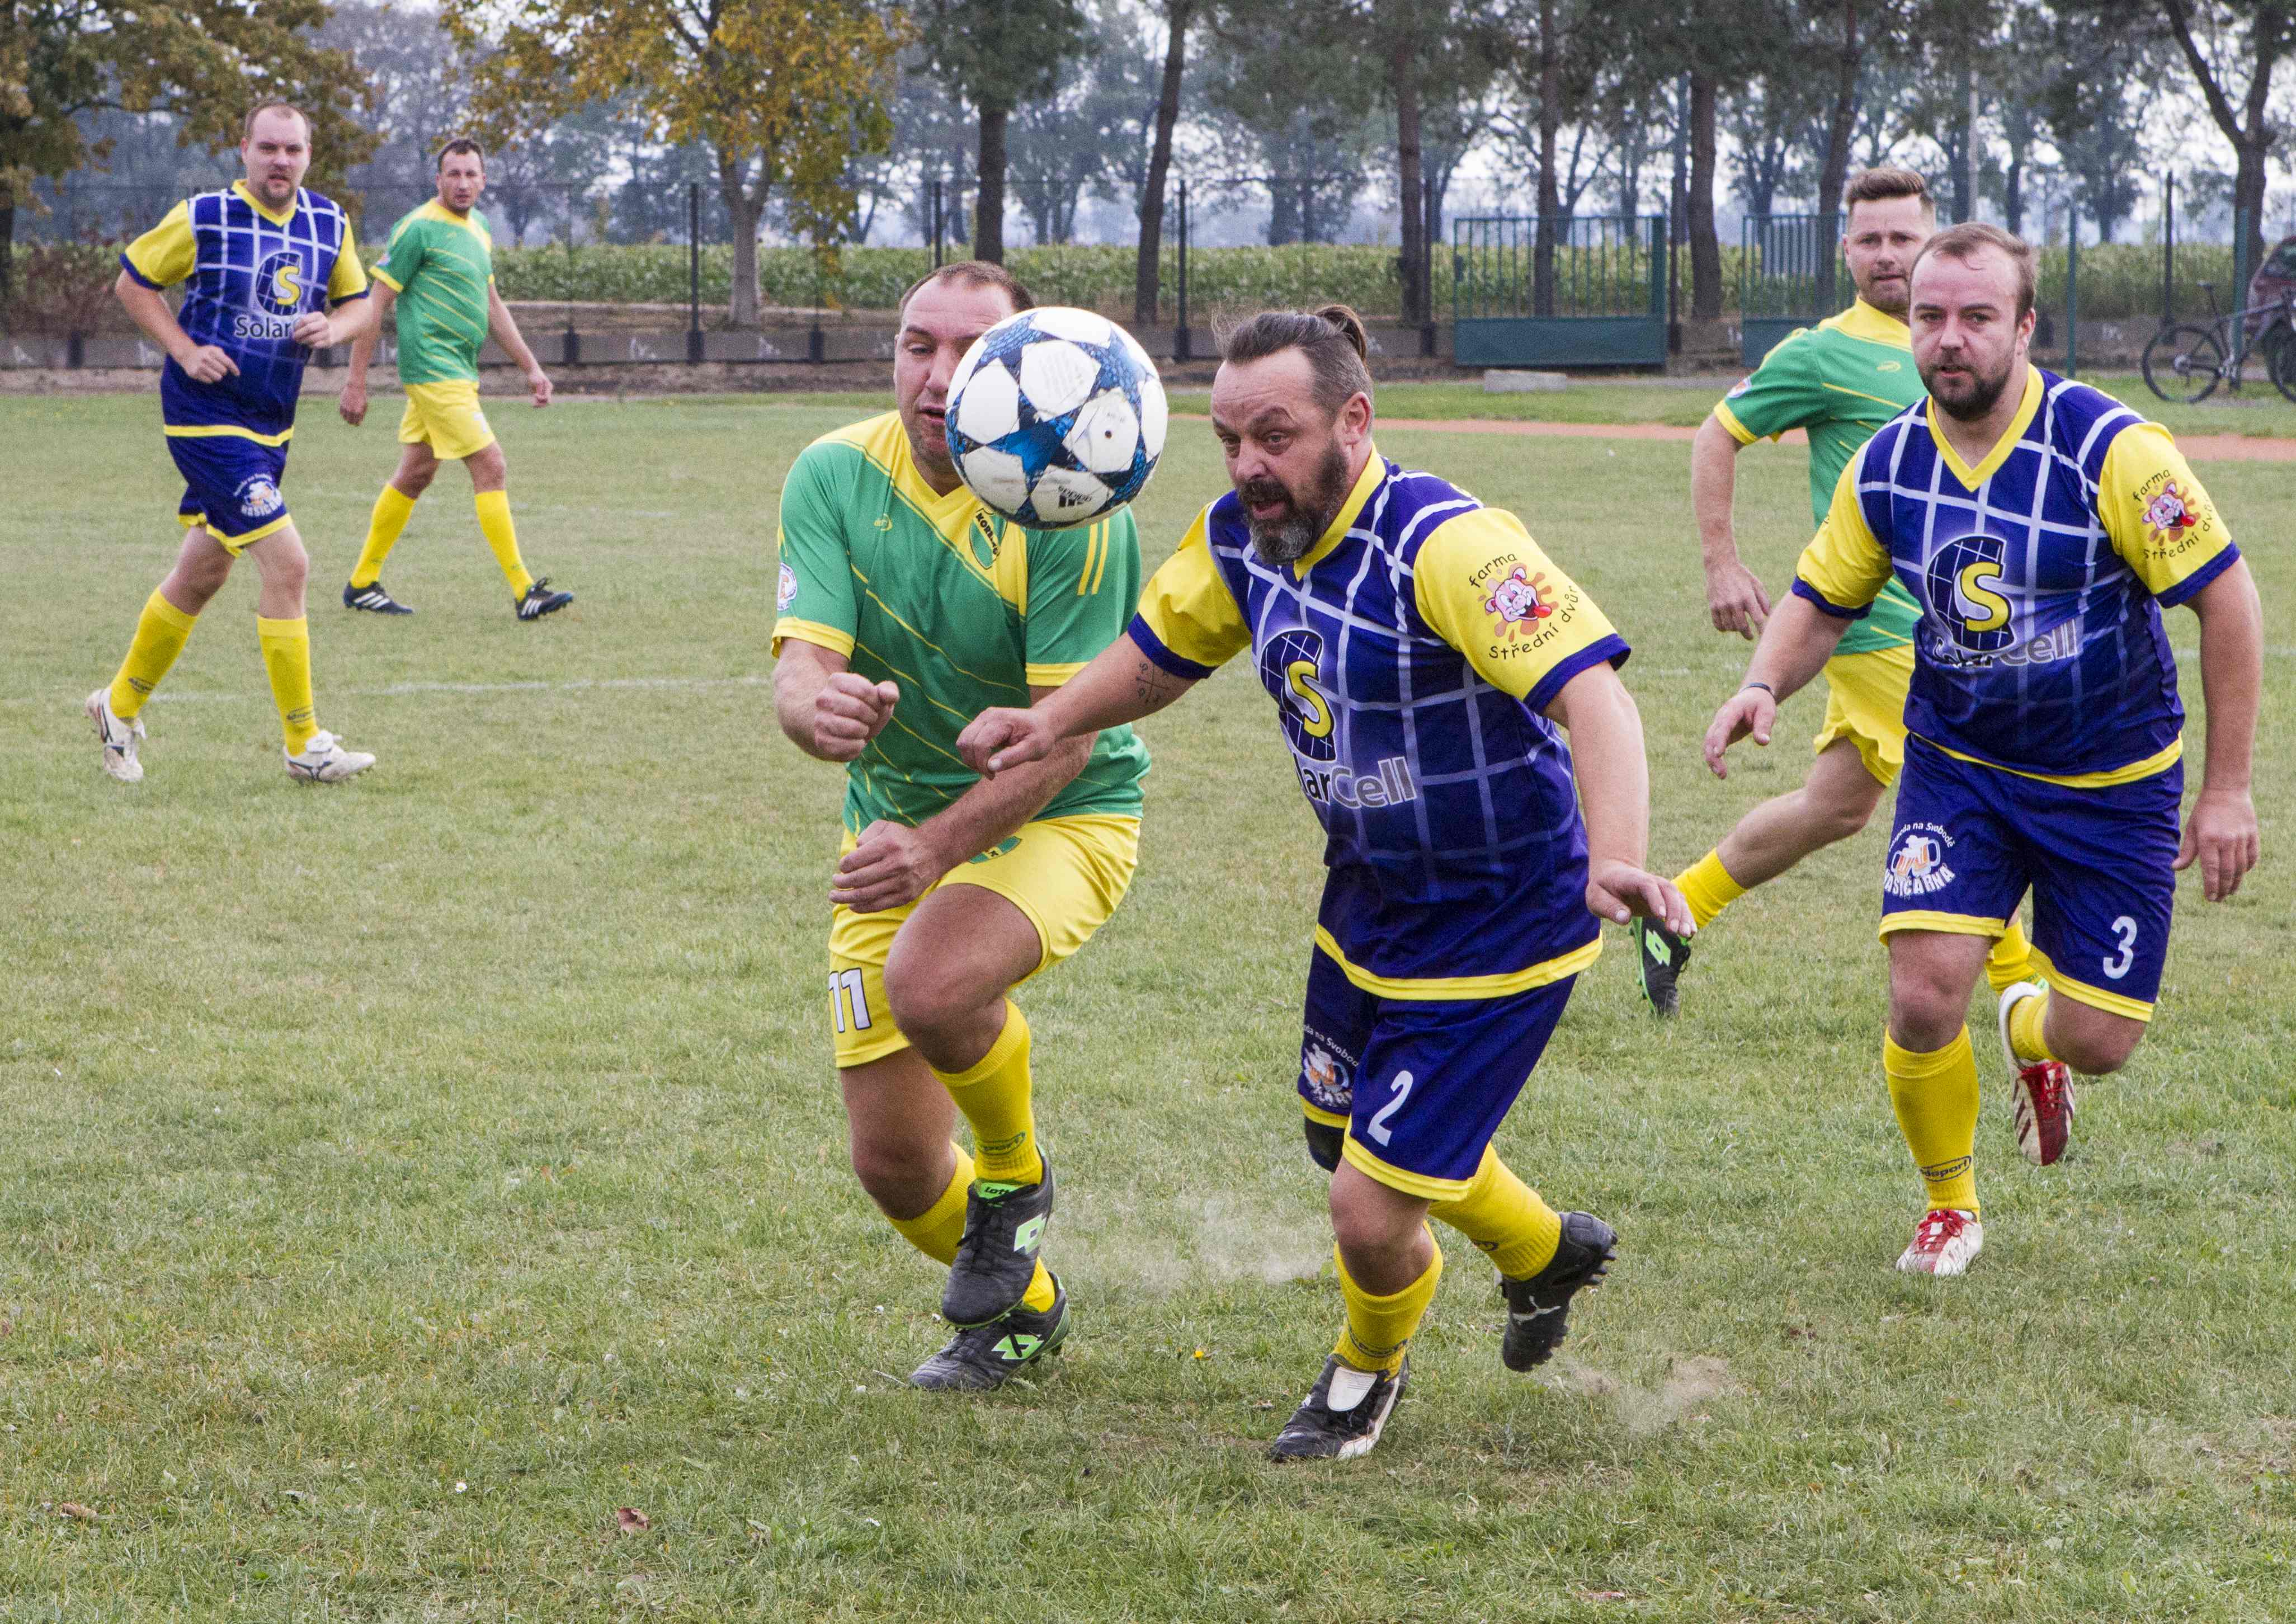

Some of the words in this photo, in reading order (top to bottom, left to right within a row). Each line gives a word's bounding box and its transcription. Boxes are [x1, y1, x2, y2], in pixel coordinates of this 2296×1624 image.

[277, 265, 301, 305] S
[235, 317, 291, 338] Solar
[2133, 469, 2171, 502] farma
[1469, 553, 1517, 588] farma
[2143, 531, 2200, 559] Střední
[1488, 622, 1559, 660] Střední
[1561, 585, 1578, 623] dvůr
[1960, 561, 2010, 632] S
[1287, 660, 1334, 738] S
[2103, 916, 2137, 980] 3
[828, 967, 872, 1033] 11
[1367, 1070, 1413, 1147] 2
